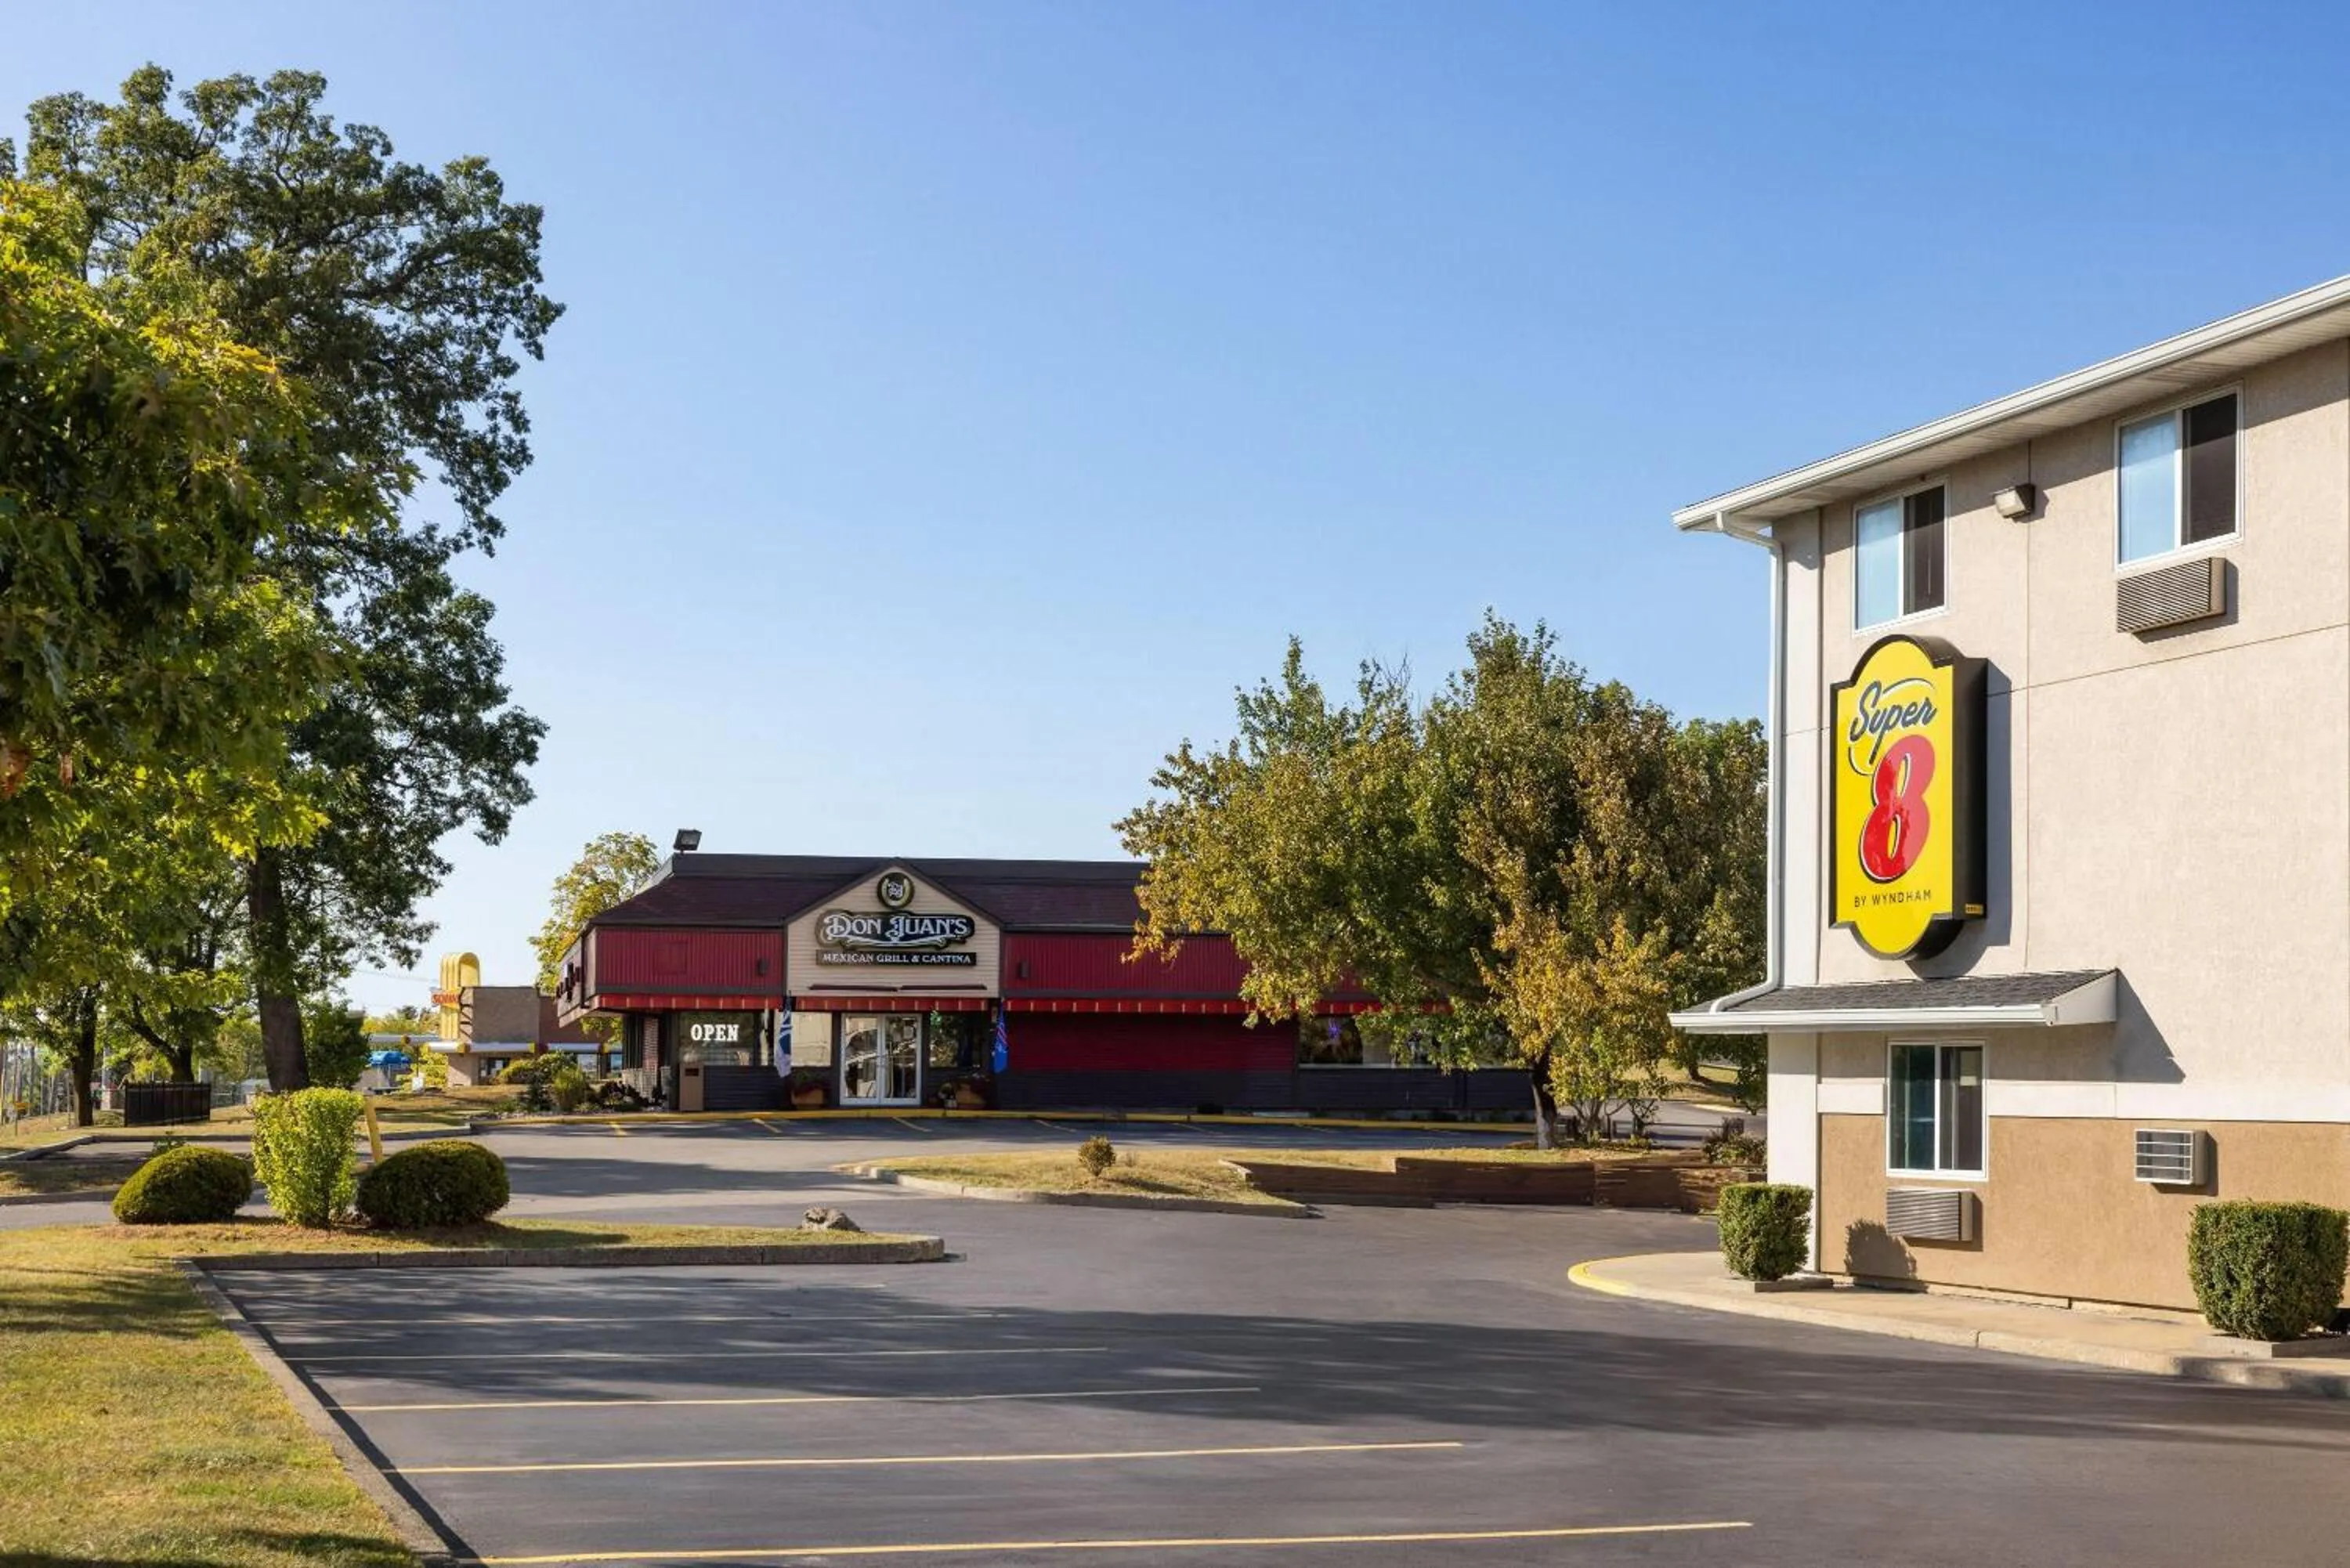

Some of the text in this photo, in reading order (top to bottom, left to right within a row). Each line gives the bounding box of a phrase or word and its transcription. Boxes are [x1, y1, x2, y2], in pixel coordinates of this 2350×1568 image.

[1849, 680, 1938, 764] Super
[1859, 734, 1936, 884] 8
[1854, 890, 1932, 908] BY WYNDHAM
[822, 953, 971, 964] MEXICAN GRILL & CANTINA
[690, 1024, 739, 1041] OPEN
